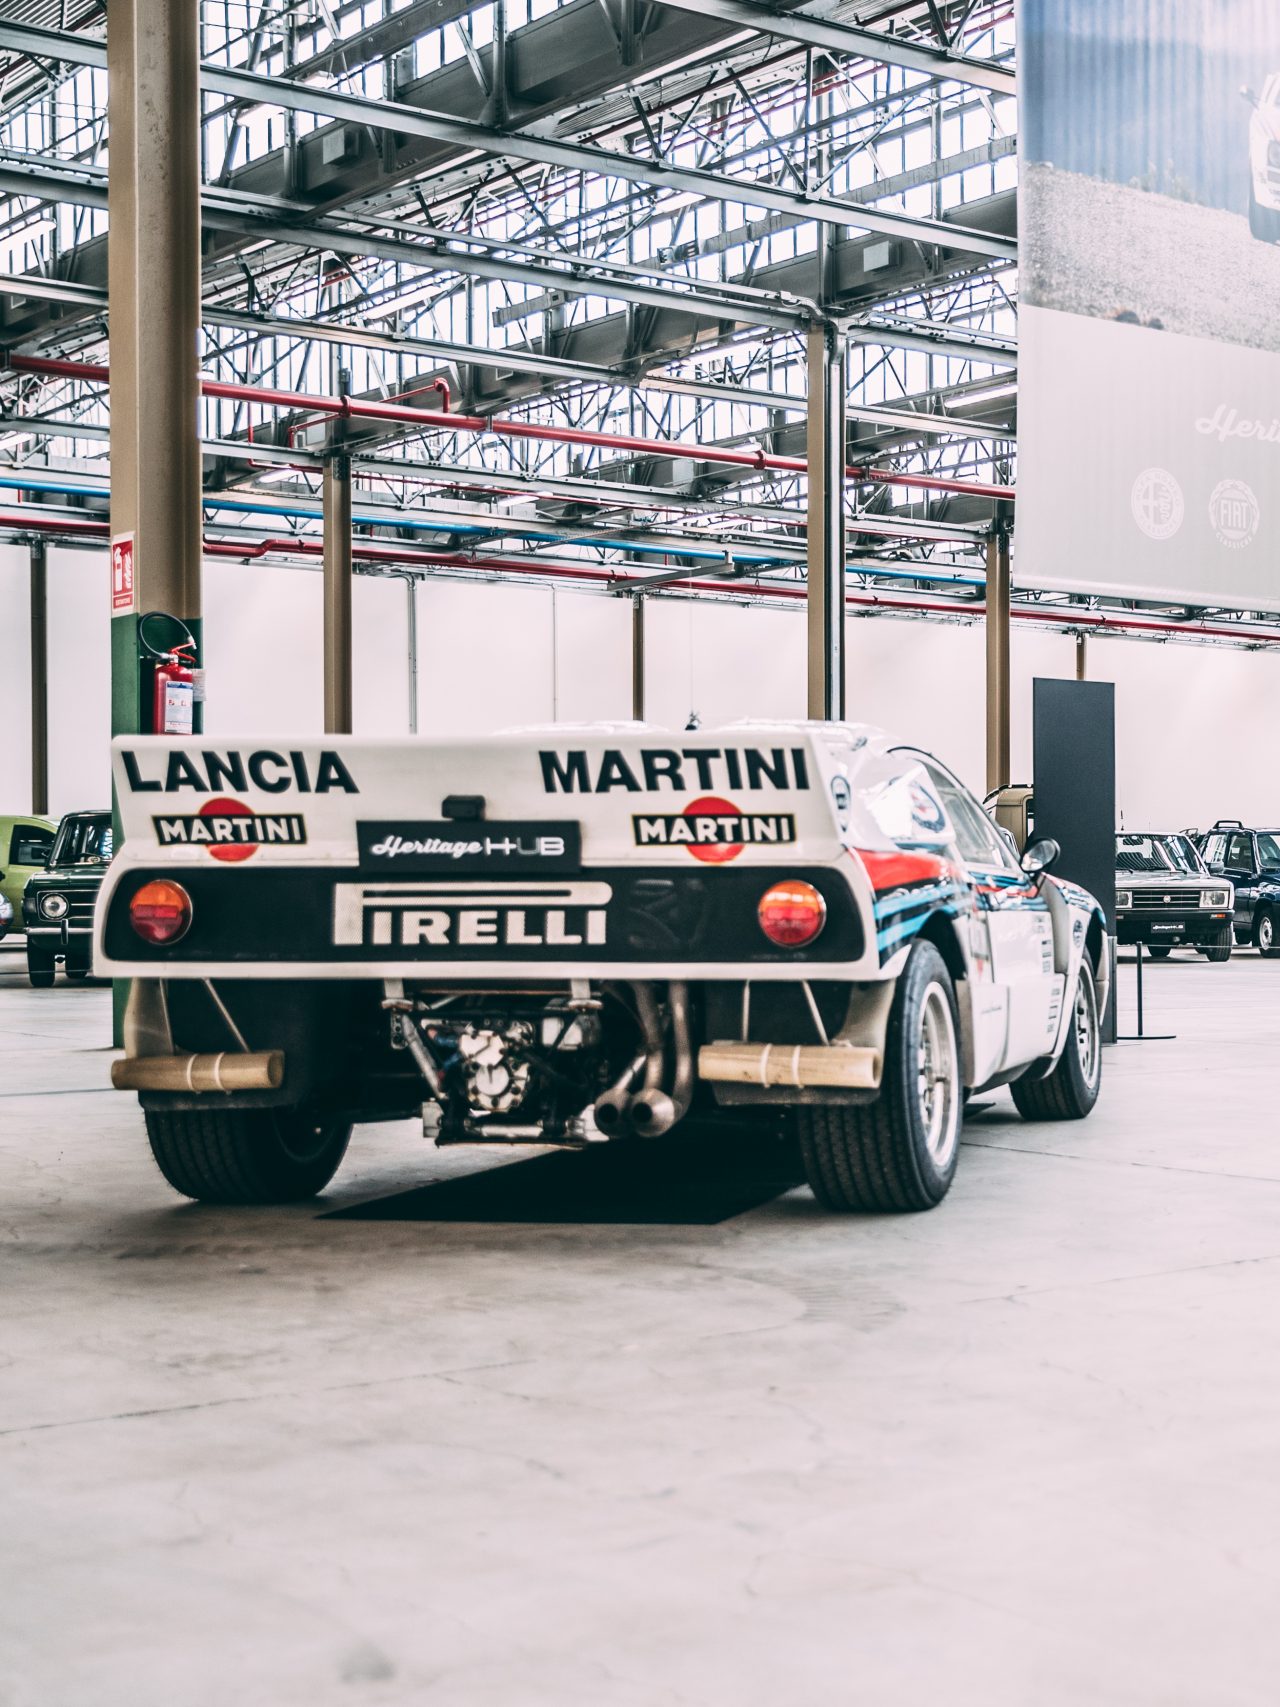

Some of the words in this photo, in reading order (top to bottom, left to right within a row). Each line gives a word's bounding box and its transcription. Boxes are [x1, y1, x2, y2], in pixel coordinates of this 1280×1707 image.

[1220, 499, 1249, 529] FIAT
[121, 750, 360, 794] LANCIA
[538, 748, 811, 794] MARTINI
[158, 817, 304, 843] MARTINI
[638, 817, 791, 843] MARTINI
[370, 835, 484, 859] Heritage
[485, 836, 565, 856] HUB
[334, 882, 613, 945] PIRELLI
